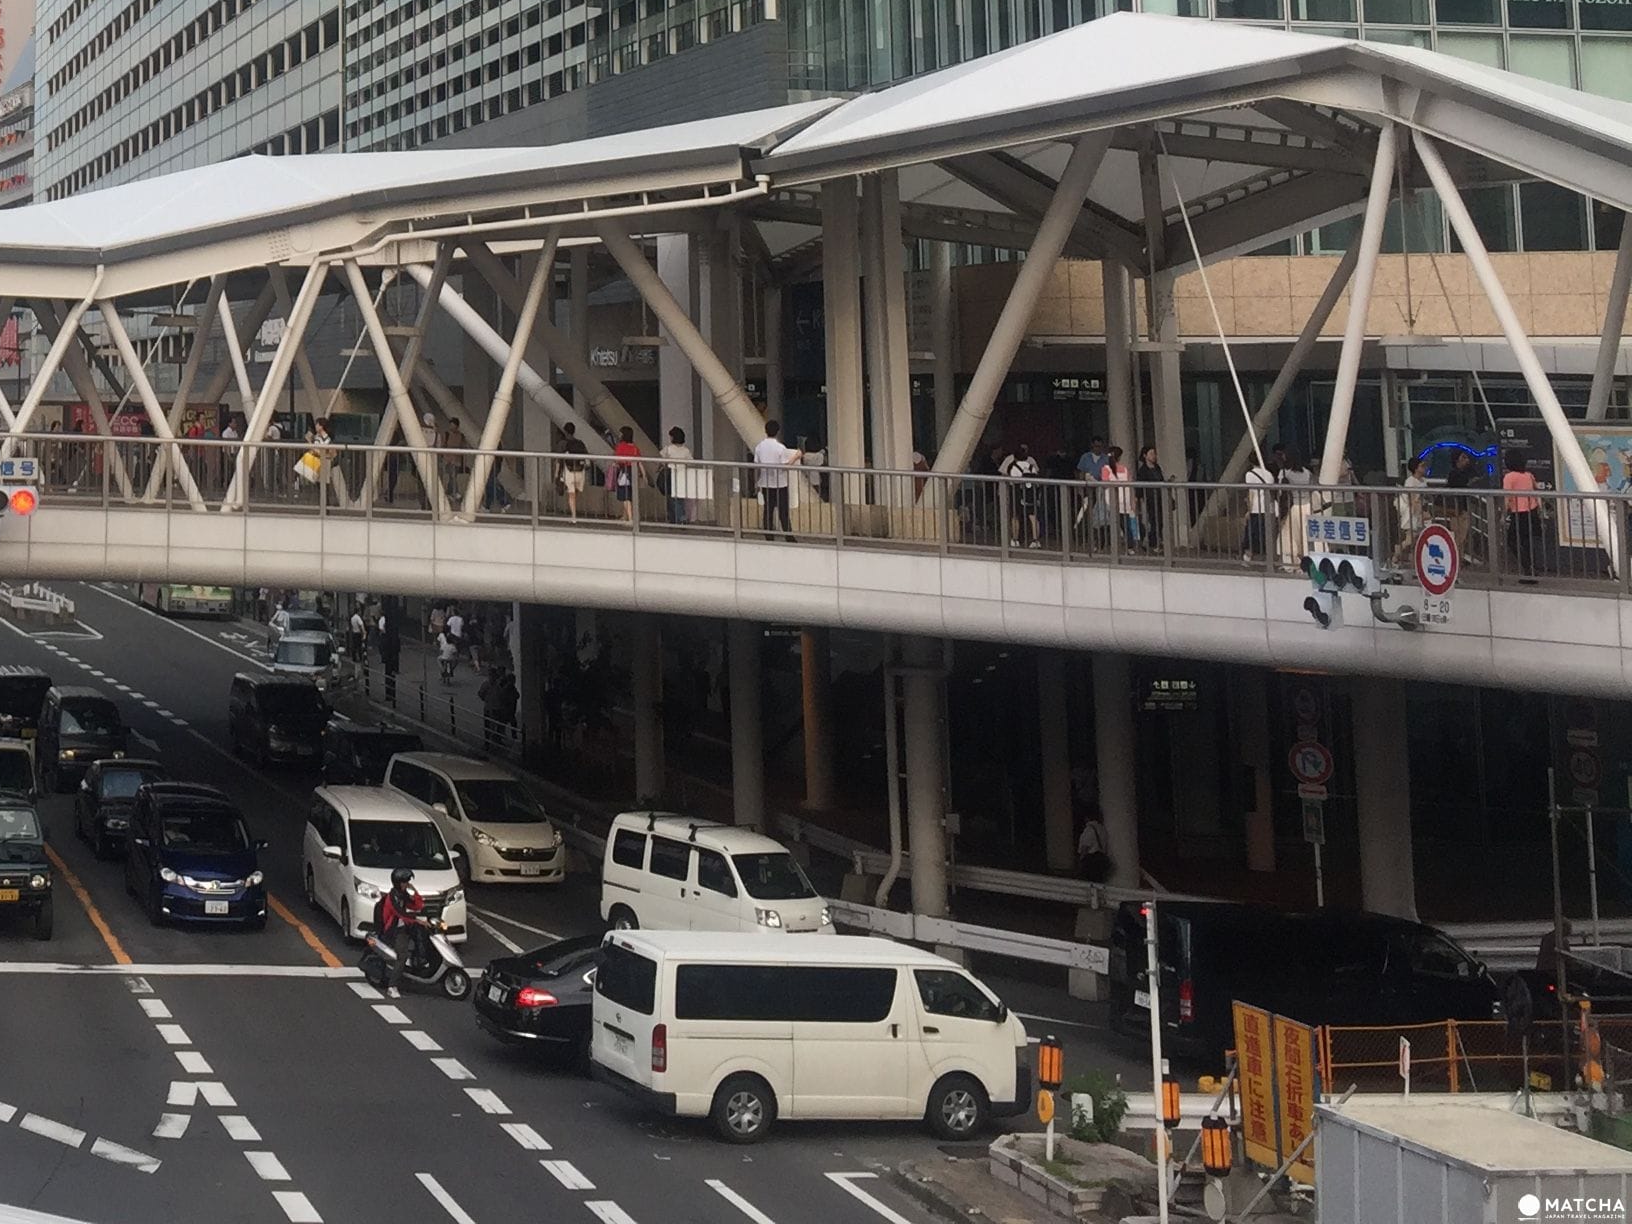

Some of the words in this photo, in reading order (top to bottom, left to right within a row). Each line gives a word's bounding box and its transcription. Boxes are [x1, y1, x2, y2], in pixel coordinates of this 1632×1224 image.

[1308, 519, 1367, 542] 時差信号
[1242, 1012, 1267, 1144] 直進車に注意
